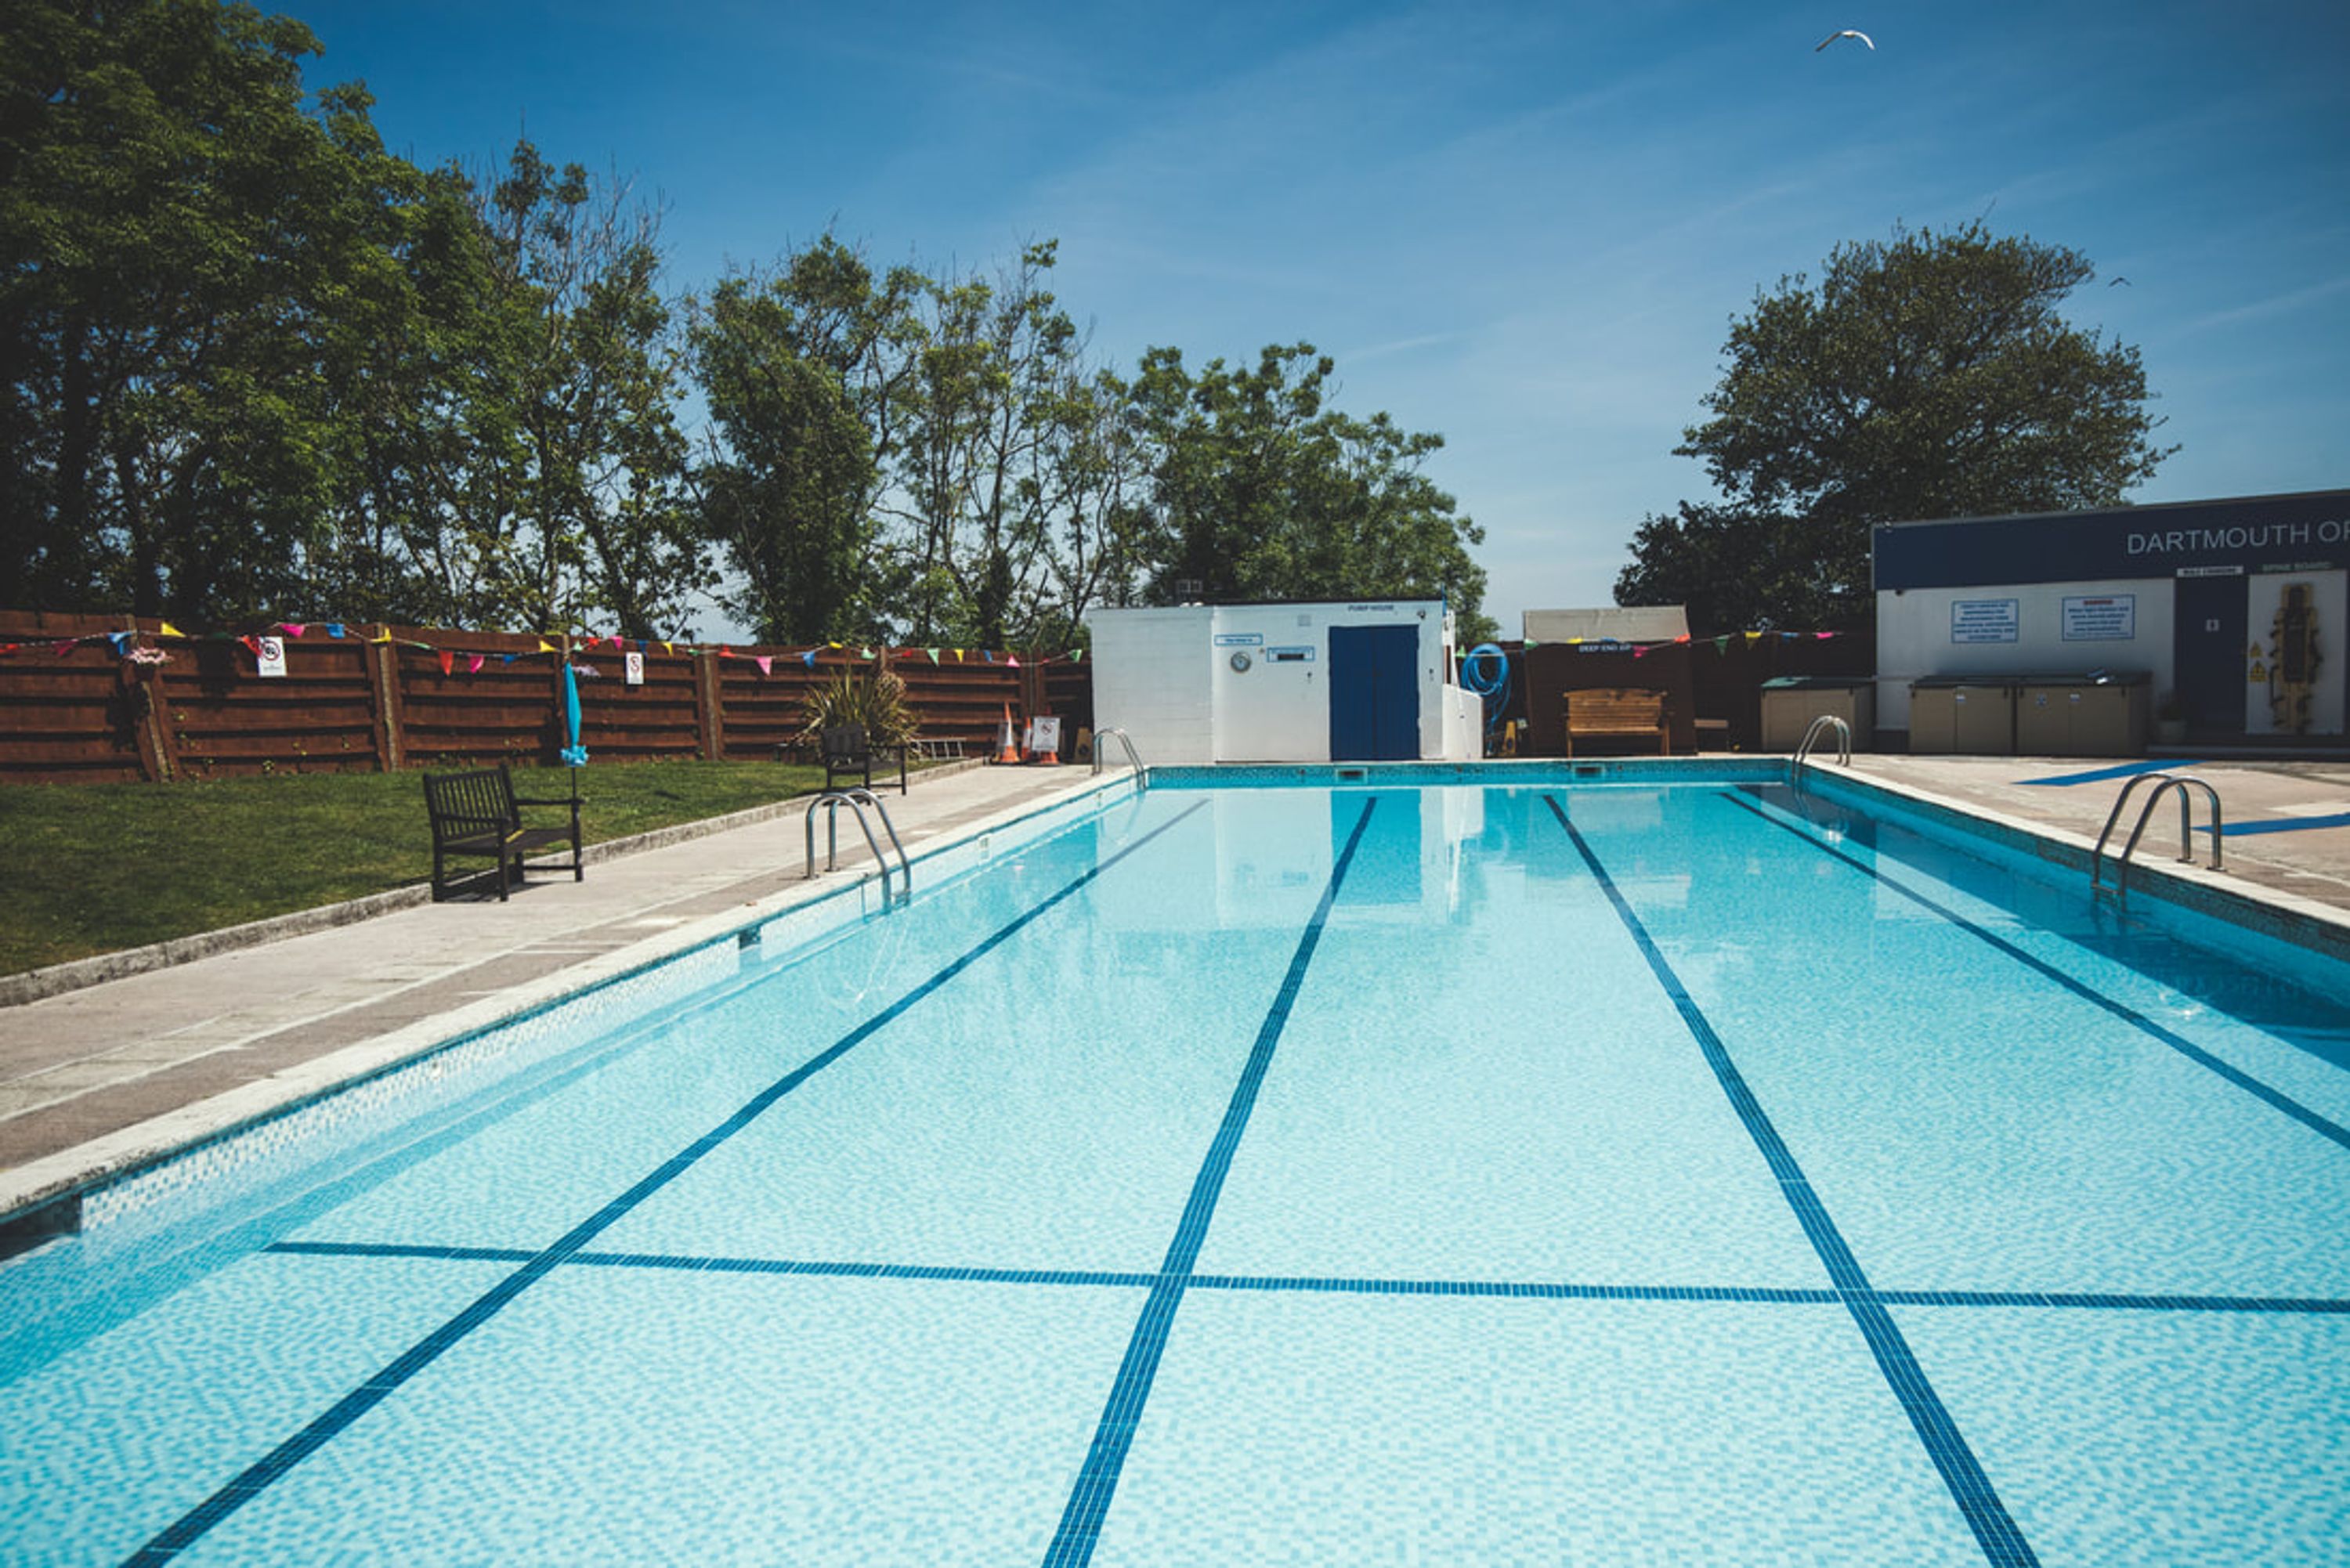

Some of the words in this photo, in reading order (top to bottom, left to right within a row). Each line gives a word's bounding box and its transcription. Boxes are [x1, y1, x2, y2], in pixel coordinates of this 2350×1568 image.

[2127, 522, 2309, 555] DARTMOUTH
[1578, 645, 1599, 653] DEEP
[1600, 644, 1618, 652] END
